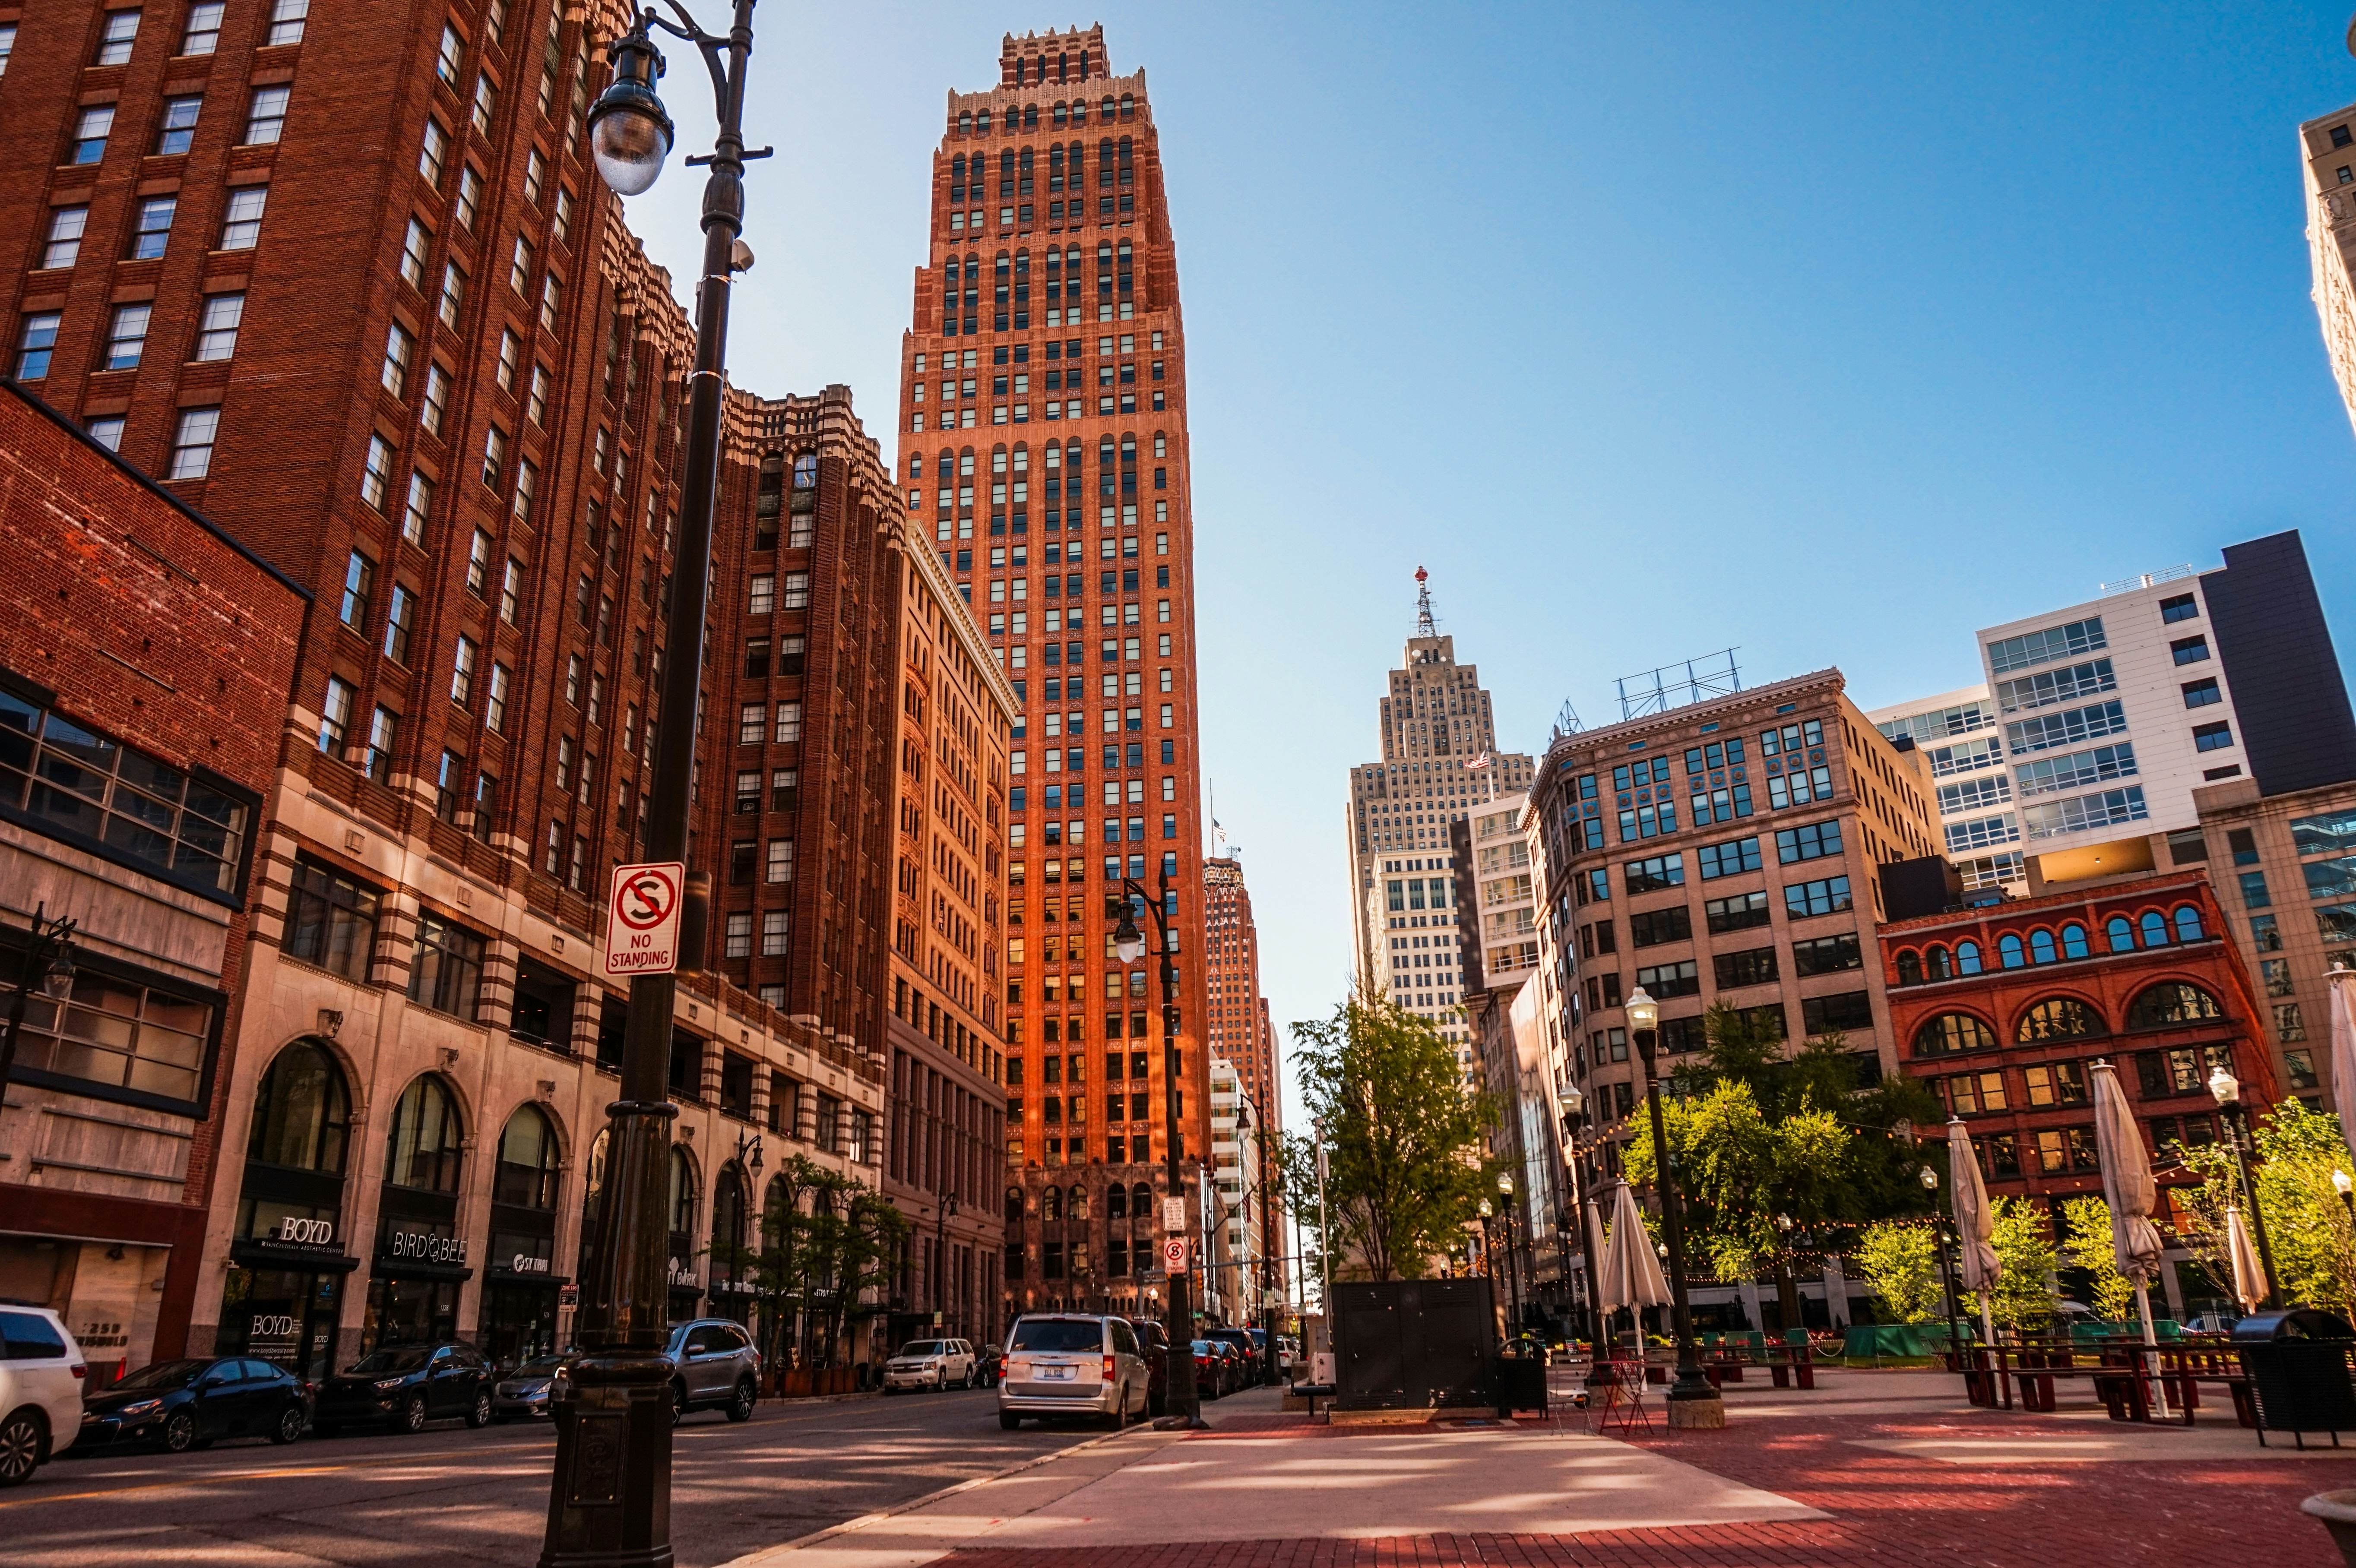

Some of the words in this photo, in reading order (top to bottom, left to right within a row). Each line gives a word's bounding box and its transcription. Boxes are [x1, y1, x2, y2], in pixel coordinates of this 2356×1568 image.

[631, 934, 651, 948] NO
[611, 951, 668, 967] STANDING
[279, 1217, 332, 1244] BOYD
[393, 1232, 427, 1258] BIRD
[440, 1238, 468, 1262] BEE
[533, 1258, 548, 1272] THAI
[677, 1268, 697, 1286] BARK
[251, 1315, 292, 1335] BOYD
[73, 1336, 128, 1347] RISWOLD
